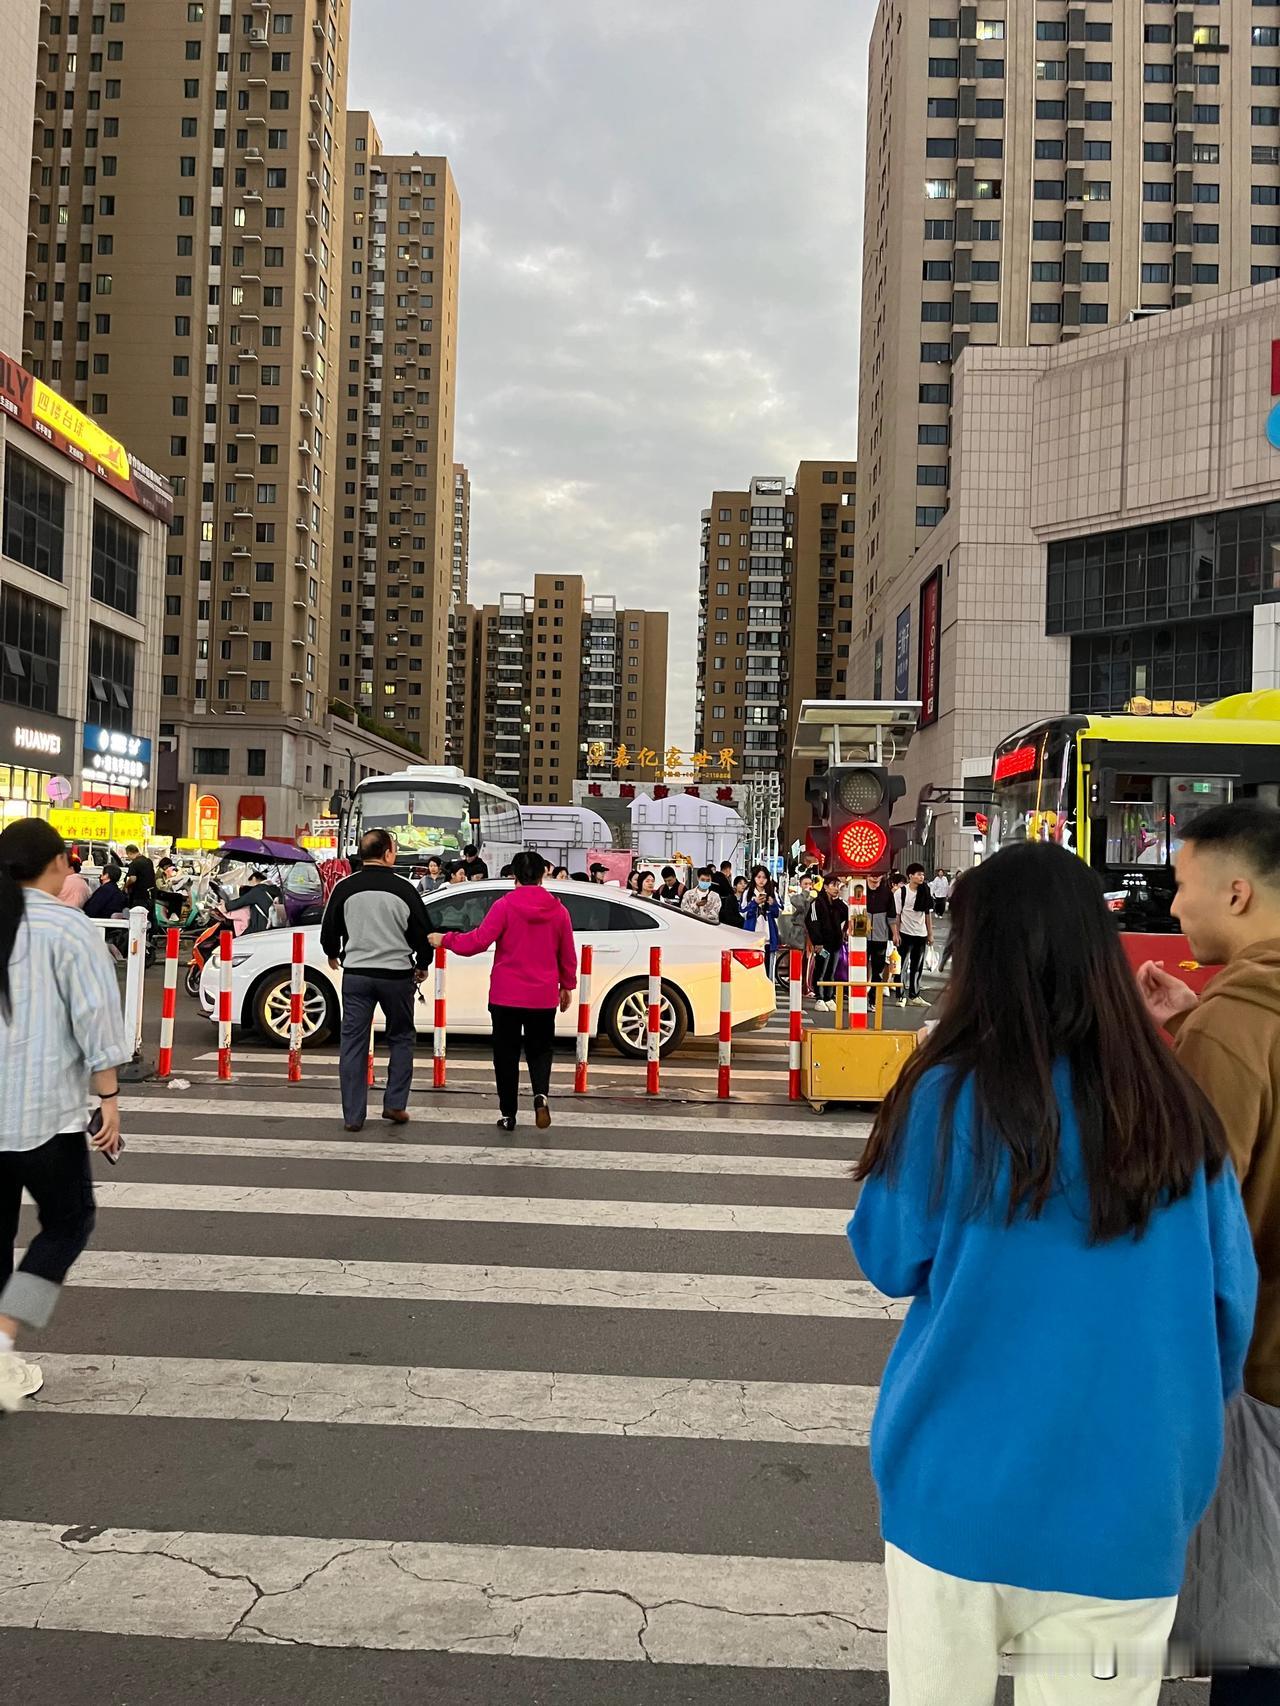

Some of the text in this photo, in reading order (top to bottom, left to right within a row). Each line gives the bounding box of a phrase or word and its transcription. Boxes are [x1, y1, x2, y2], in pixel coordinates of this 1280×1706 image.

[37, 391, 84, 438] 四楼台球
[15, 726, 61, 754] HUAWEI
